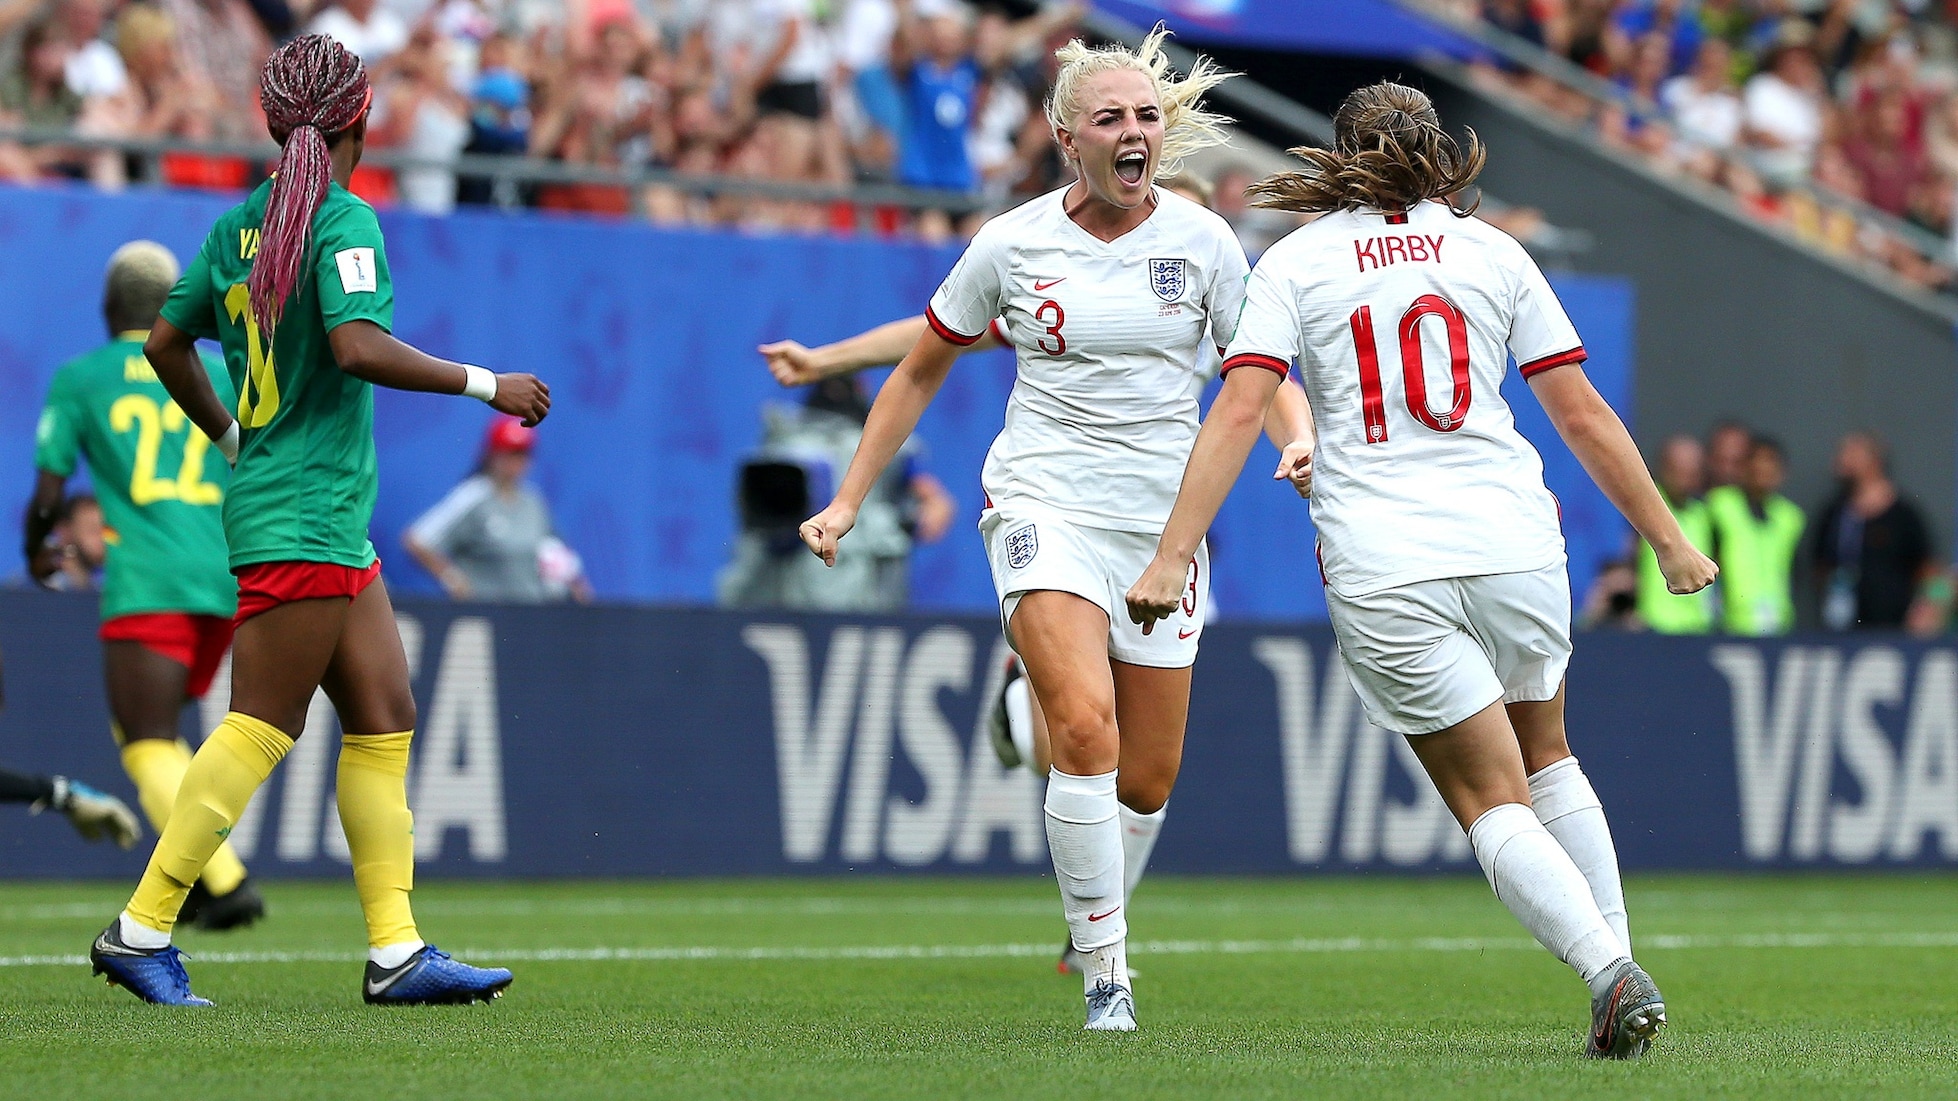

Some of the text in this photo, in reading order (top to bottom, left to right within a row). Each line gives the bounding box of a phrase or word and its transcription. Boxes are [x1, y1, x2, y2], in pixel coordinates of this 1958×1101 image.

[1354, 234, 1445, 273] KIRBY
[1035, 299, 1067, 356] 3
[1349, 293, 1473, 445] 10
[109, 392, 224, 506] 22
[1182, 556, 1199, 618] 3
[740, 622, 1046, 866] VISA
[1251, 634, 1473, 867] VIS
[1708, 644, 1958, 865] VISA
